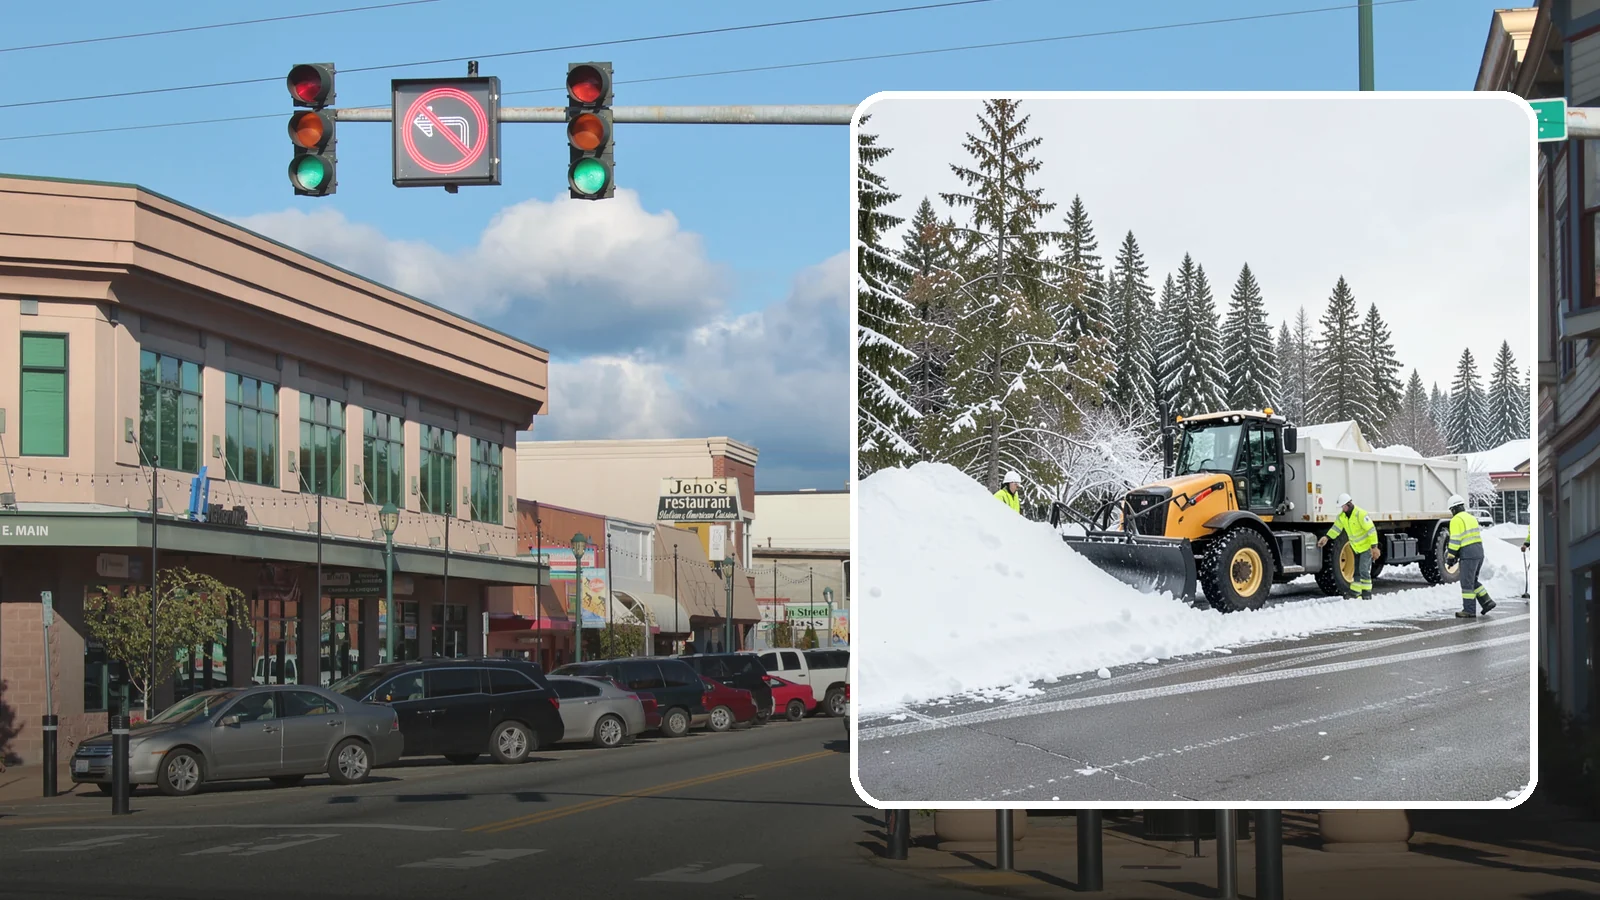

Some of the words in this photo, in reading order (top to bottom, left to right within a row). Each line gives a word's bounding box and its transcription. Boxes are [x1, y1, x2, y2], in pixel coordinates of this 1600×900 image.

[669, 479, 727, 495] Jeno's
[665, 496, 731, 509] restaurant
[658, 509, 681, 520] Italian
[686, 509, 714, 519] American
[715, 509, 737, 519] Cuisine
[2, 525, 13, 536] E.
[15, 525, 49, 536] MAIN
[797, 607, 828, 617] Street
[790, 619, 823, 627] lass
